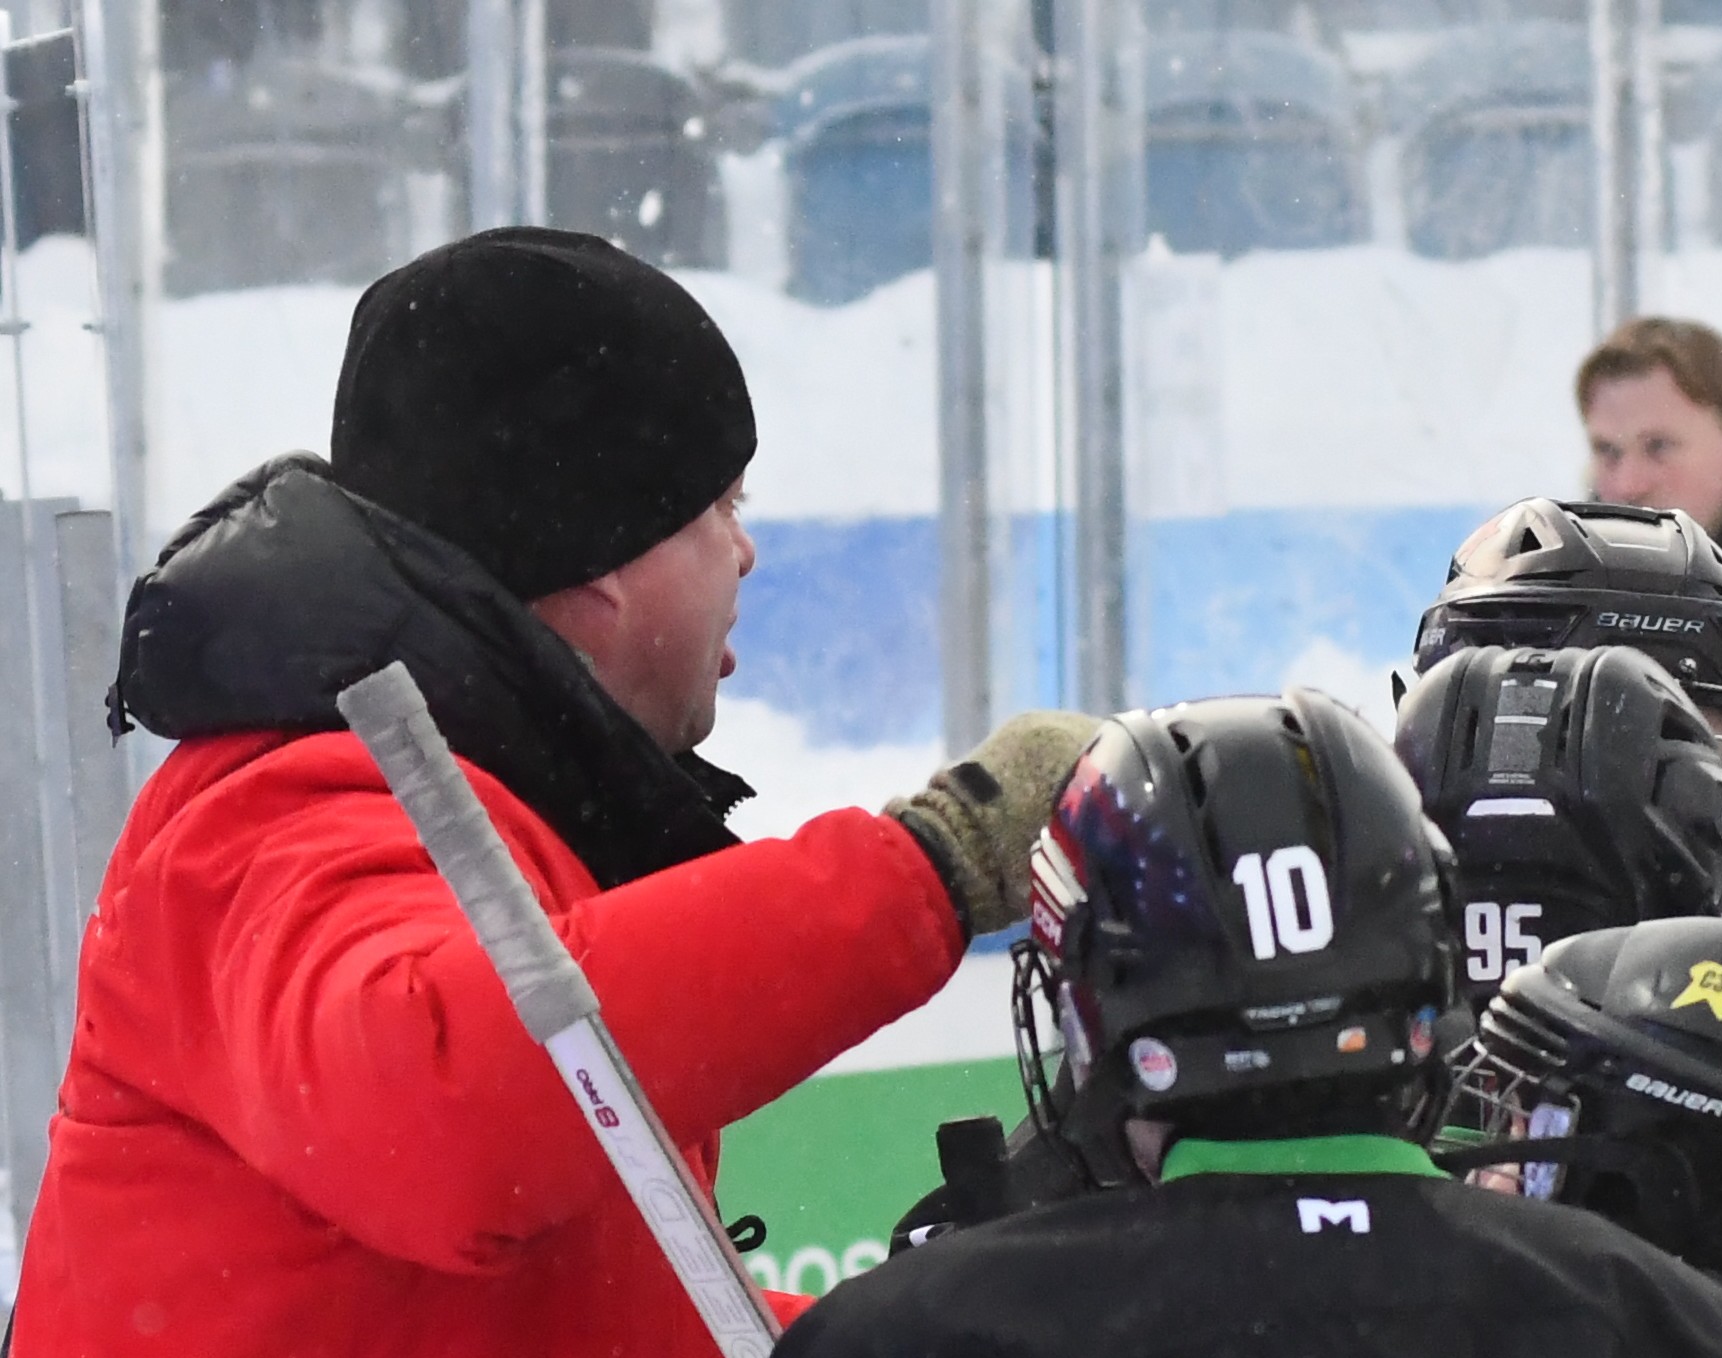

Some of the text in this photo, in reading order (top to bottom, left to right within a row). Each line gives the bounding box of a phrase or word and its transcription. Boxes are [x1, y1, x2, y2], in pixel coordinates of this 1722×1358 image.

[1597, 612, 1705, 634] BAUER
[1233, 845, 1334, 960] 10
[1464, 903, 1542, 981] 95
